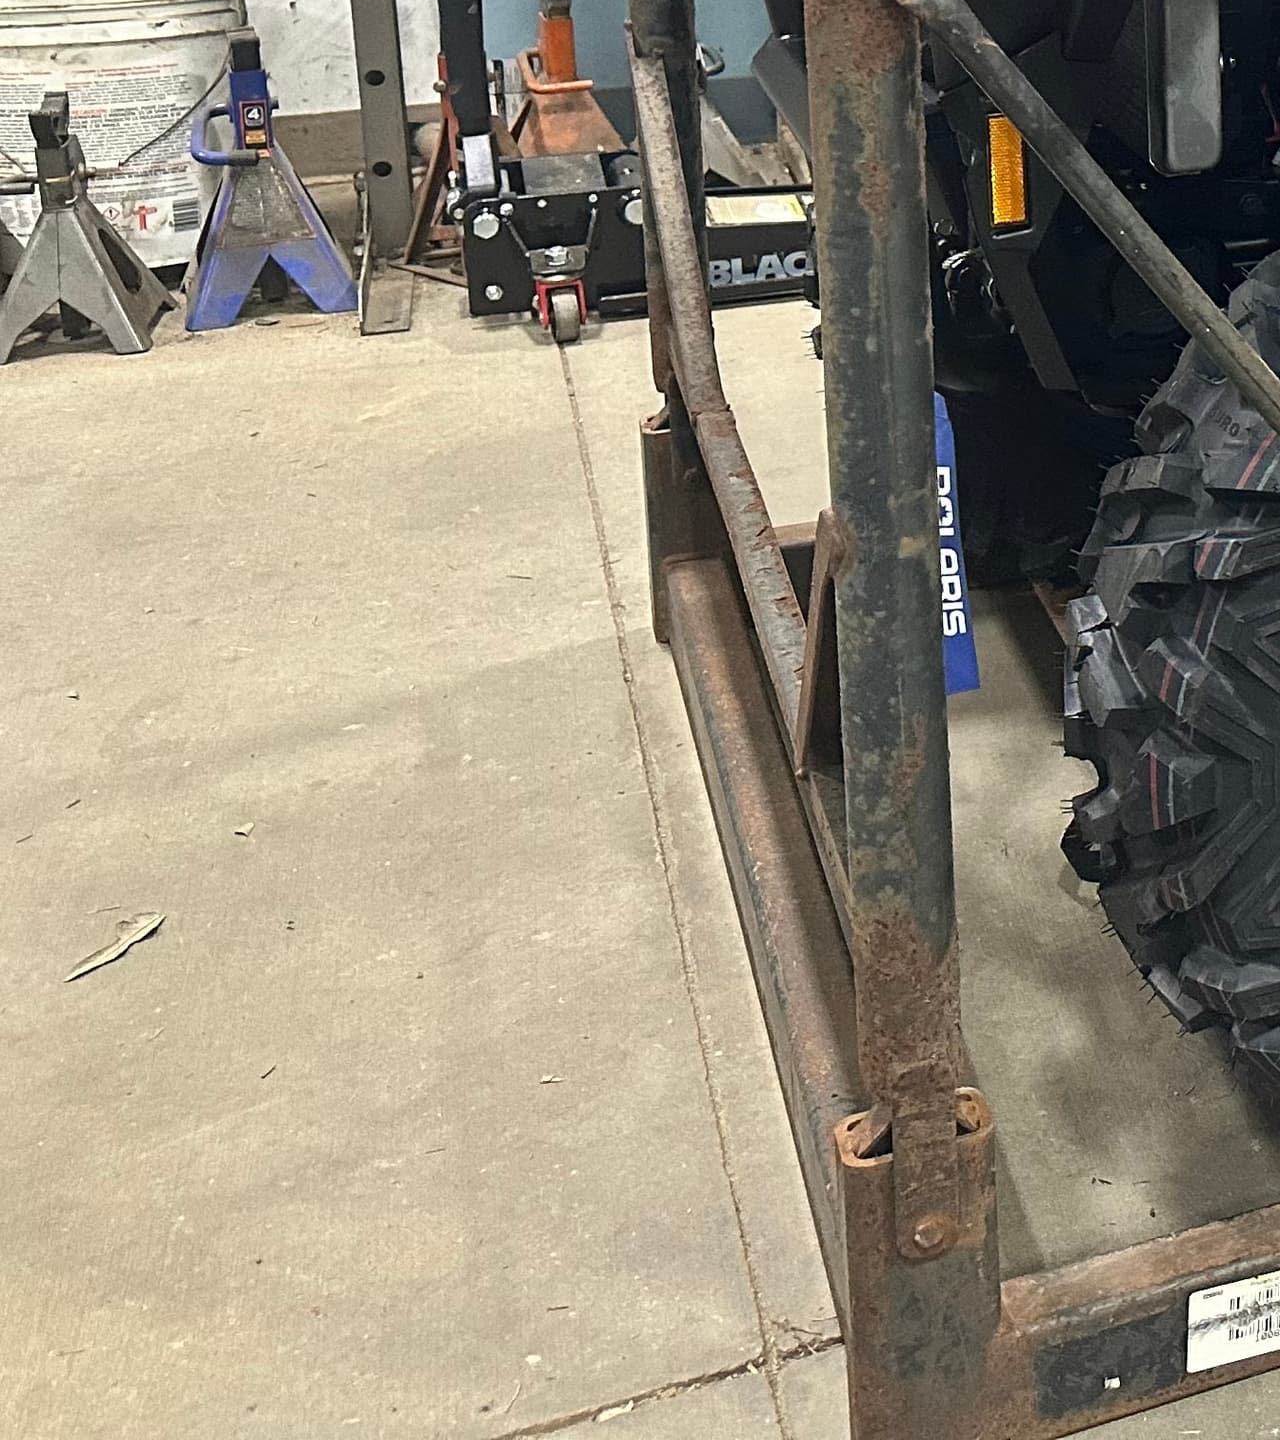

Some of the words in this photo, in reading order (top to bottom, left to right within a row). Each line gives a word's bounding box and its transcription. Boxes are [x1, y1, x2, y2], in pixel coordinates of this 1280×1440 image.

[247, 107, 260, 120] 4
[708, 250, 812, 288] BLAC
[936, 466, 967, 637] POLARIS
